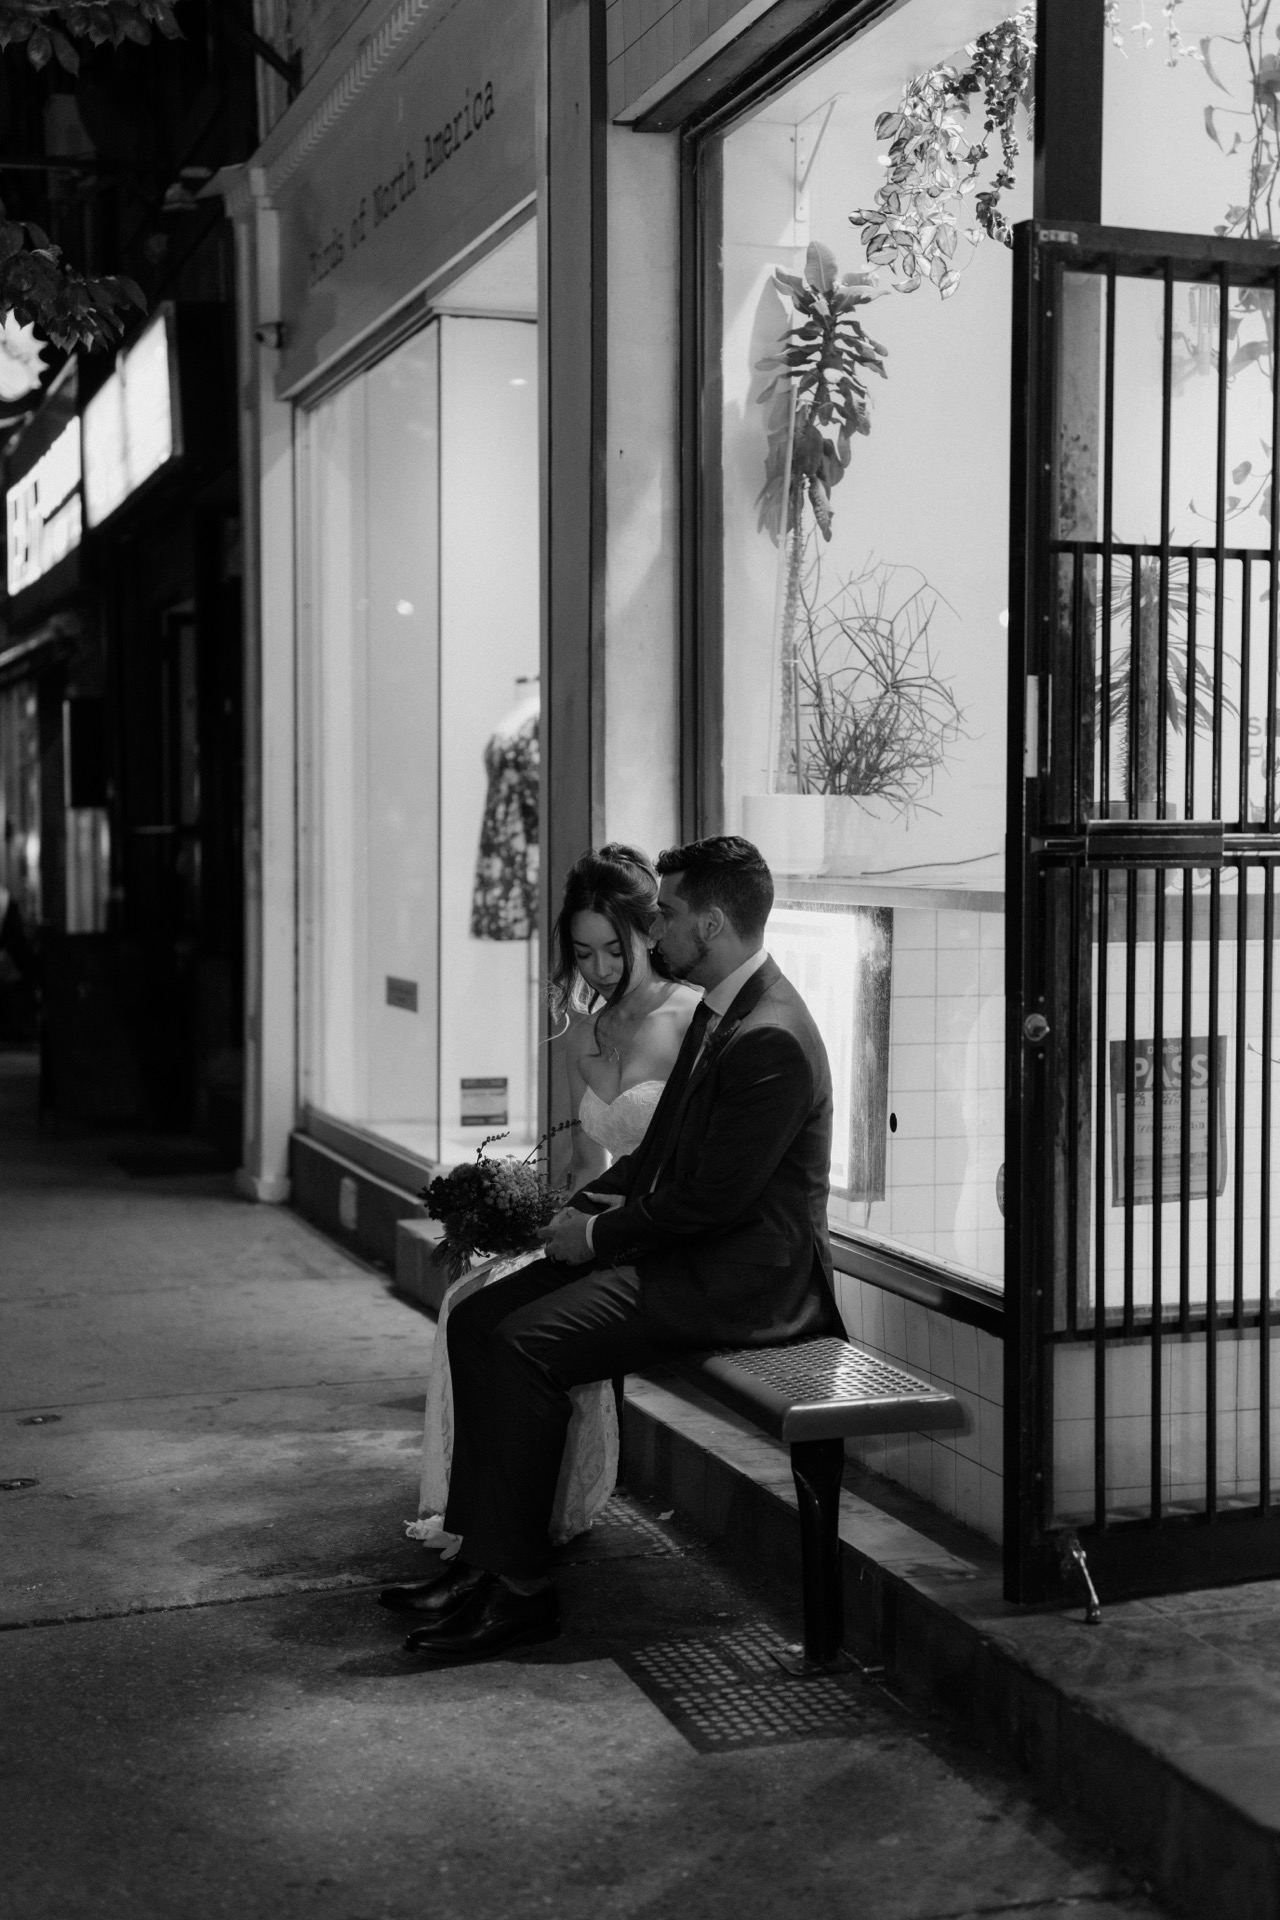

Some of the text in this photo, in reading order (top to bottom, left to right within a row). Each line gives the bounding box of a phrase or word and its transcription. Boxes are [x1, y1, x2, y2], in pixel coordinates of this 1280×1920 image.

[372, 151, 417, 228] North
[423, 79, 496, 180] America
[1130, 1053, 1209, 1090] PASS
